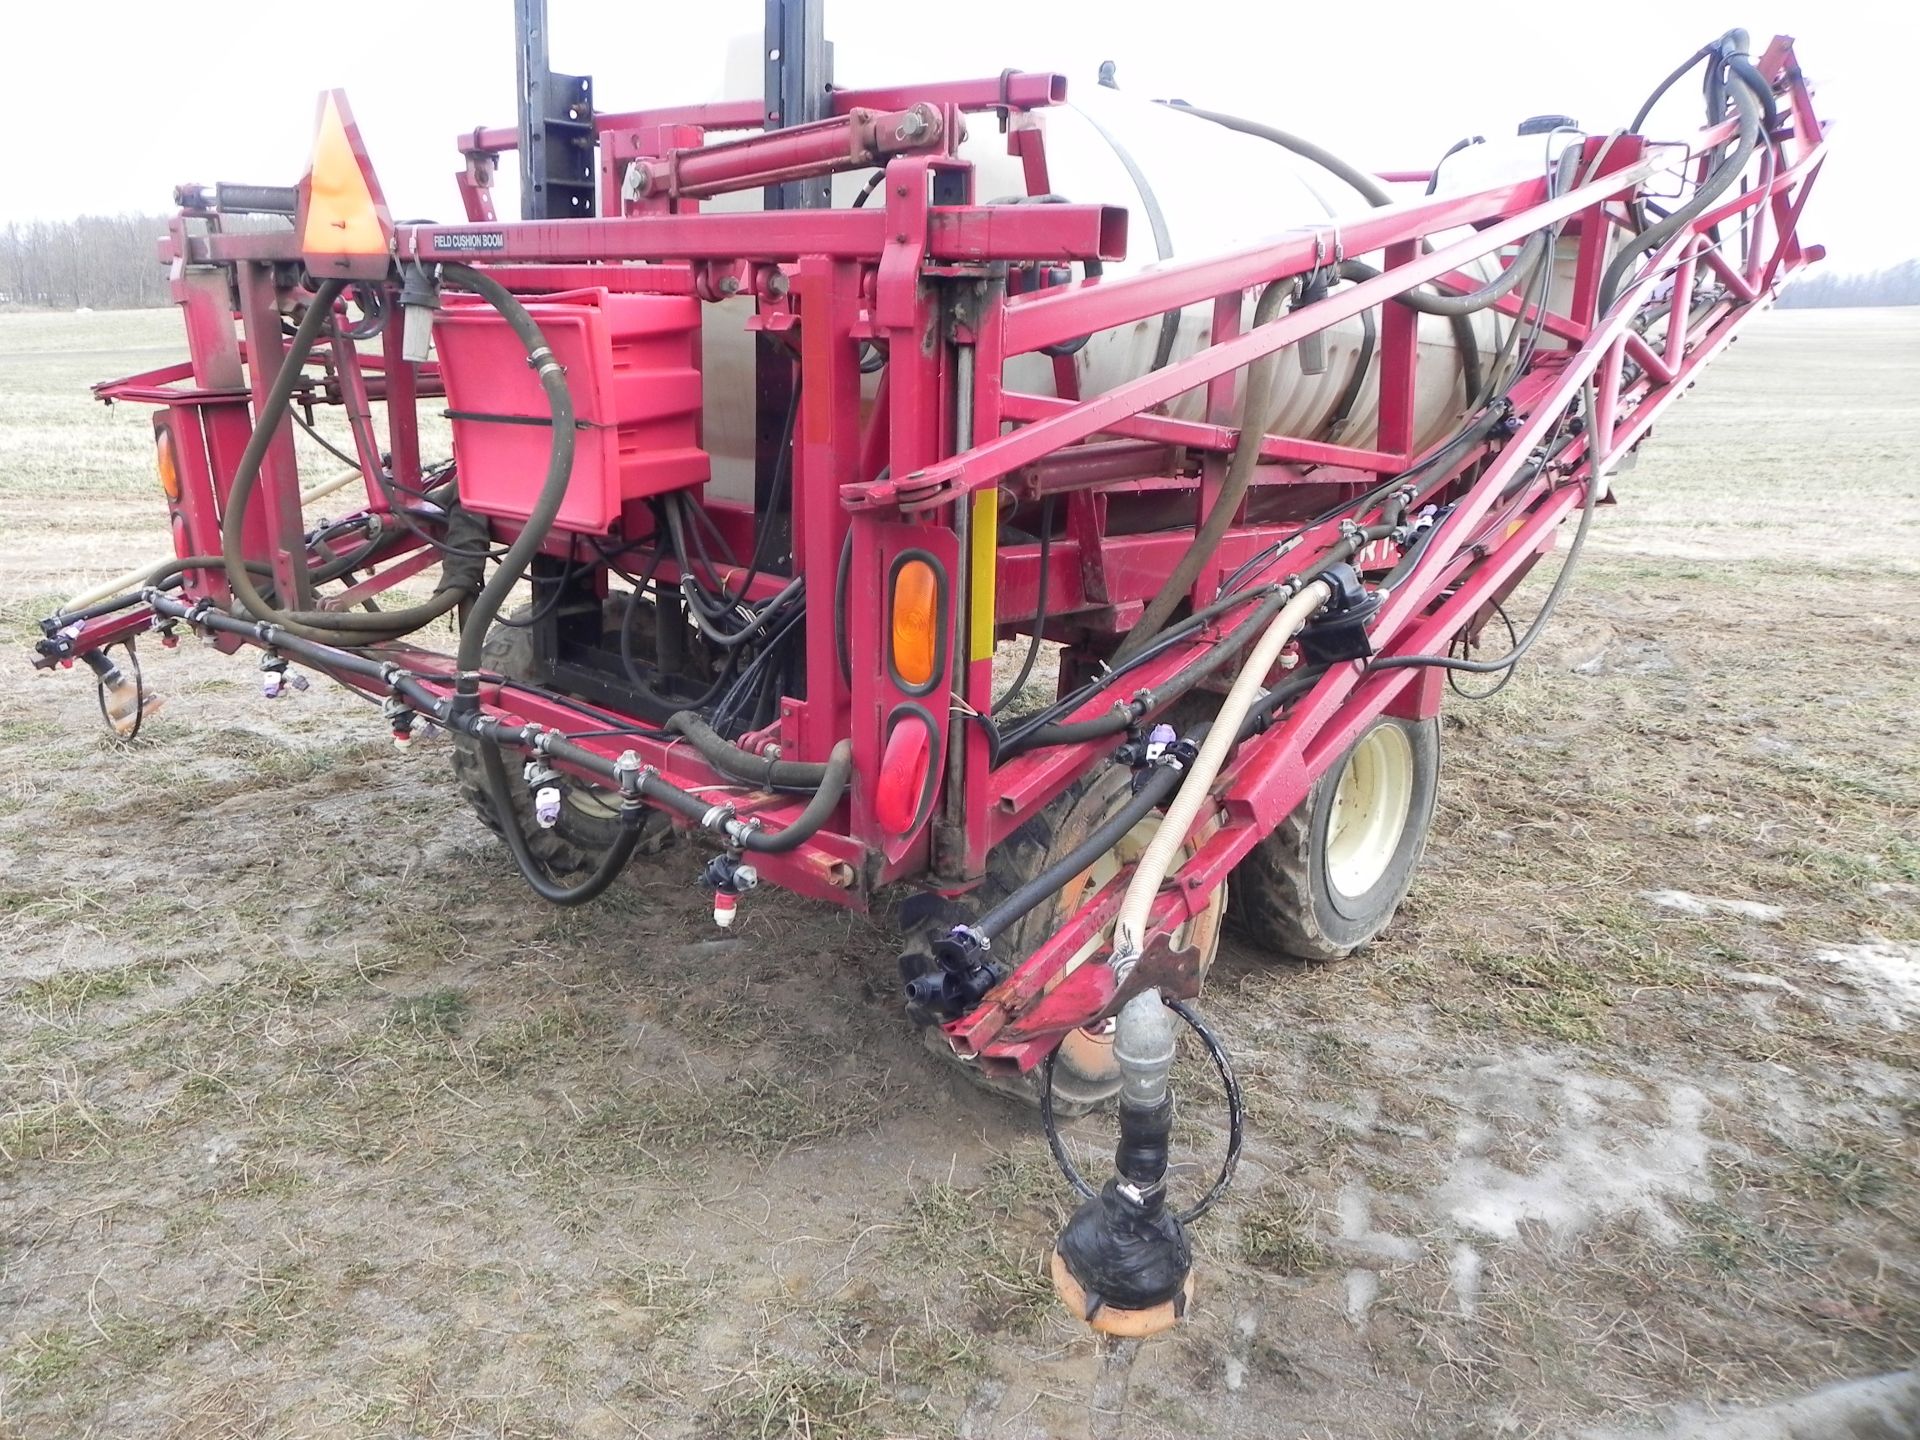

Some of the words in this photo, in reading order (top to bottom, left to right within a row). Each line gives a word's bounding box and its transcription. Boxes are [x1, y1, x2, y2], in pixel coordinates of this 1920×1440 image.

[434, 235, 452, 248] FIELD
[452, 234, 482, 248] CUSHION
[483, 233, 504, 247] BOOM
